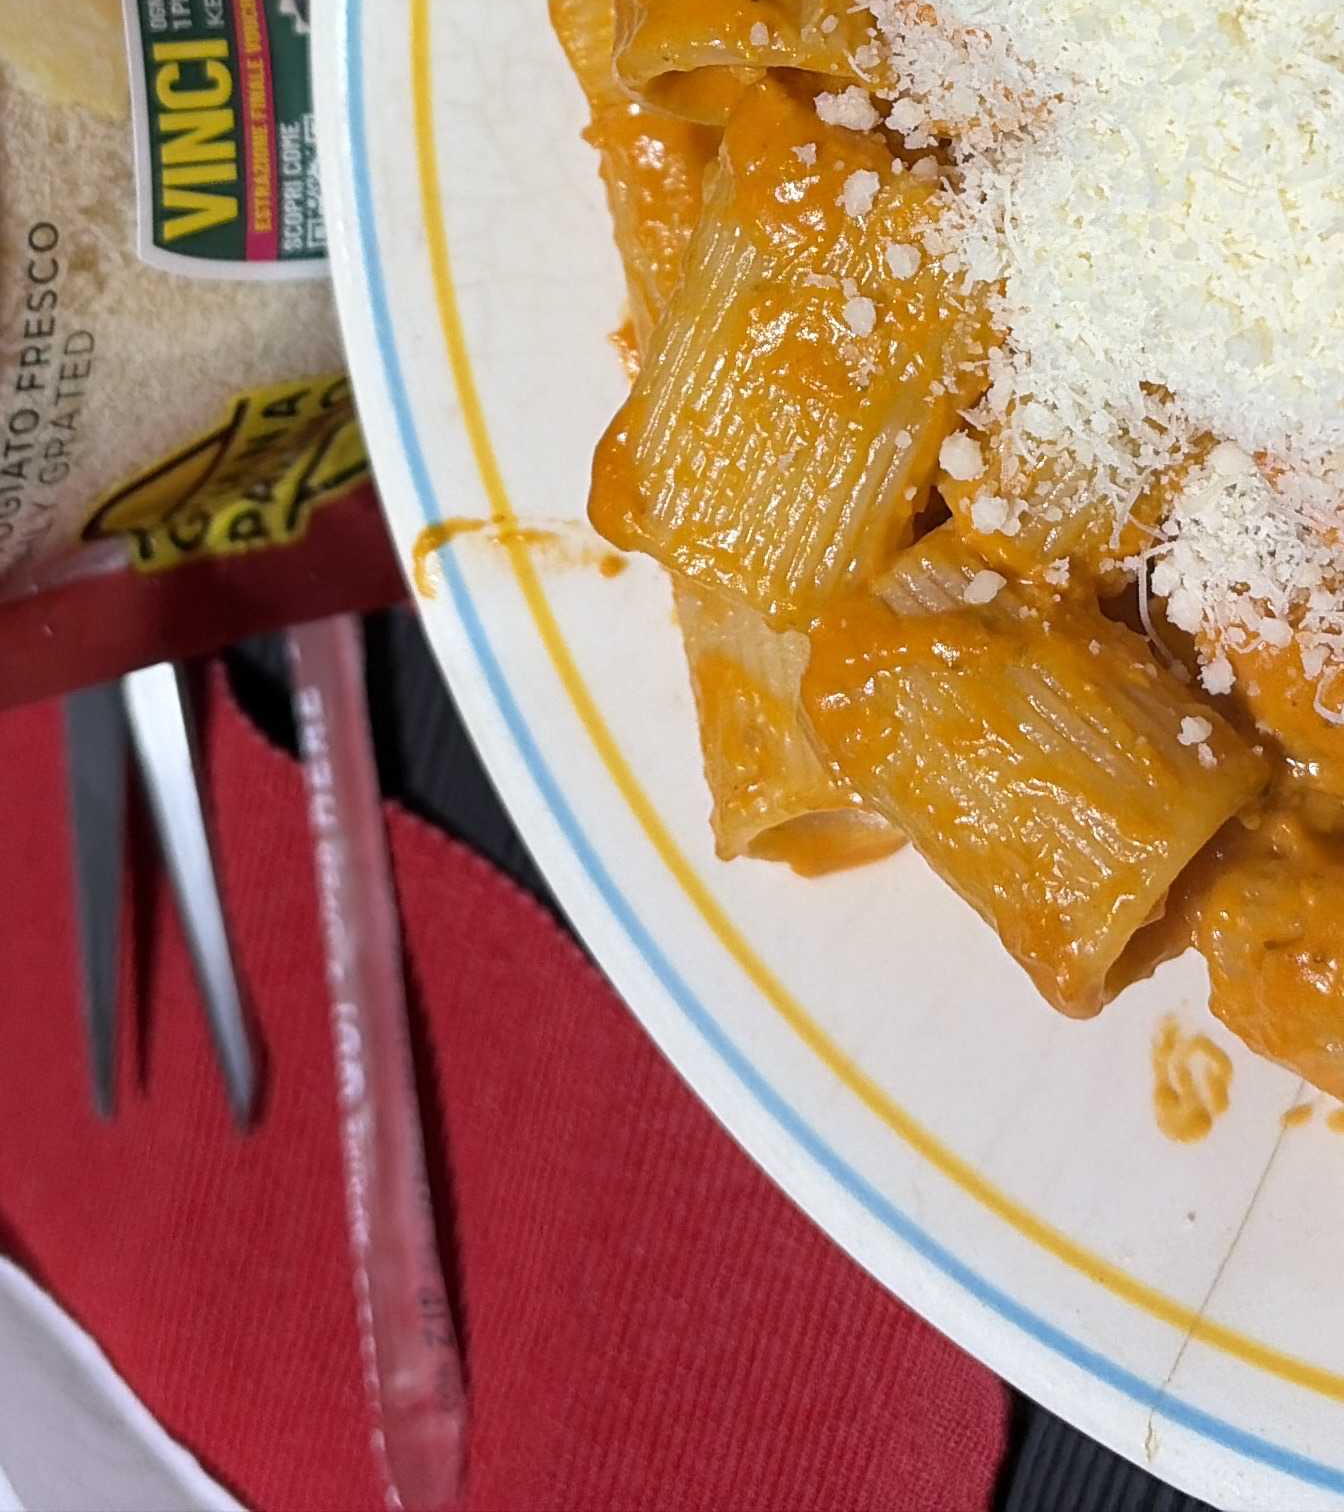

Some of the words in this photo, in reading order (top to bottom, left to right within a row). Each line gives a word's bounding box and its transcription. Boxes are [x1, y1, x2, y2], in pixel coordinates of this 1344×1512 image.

[152, 36, 240, 241] VINCI
[245, 57, 268, 120] FINALE
[249, 124, 273, 232] ESTRAZIONE
[279, 120, 302, 175] COME
[280, 178, 304, 250] SCOPRI
[14, 219, 60, 391] FRESCO
[37, 327, 96, 484] GRATED
